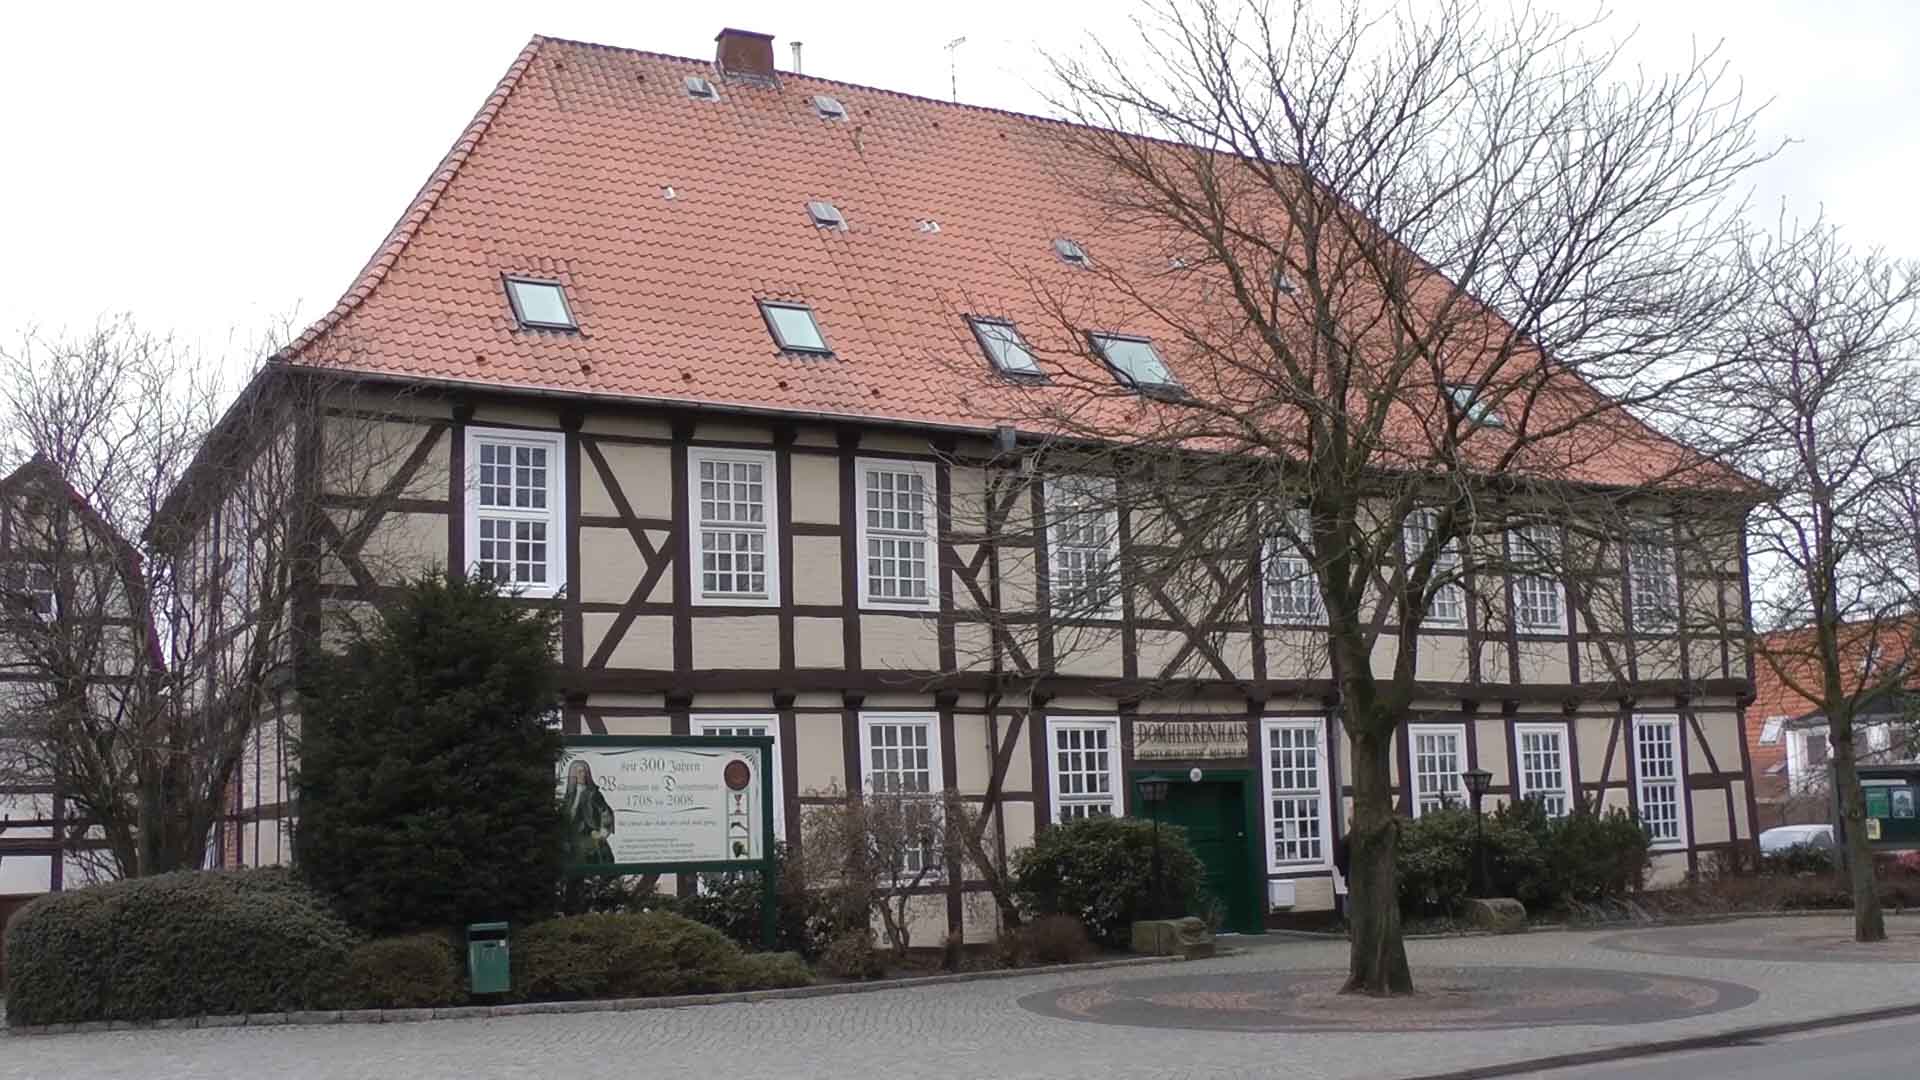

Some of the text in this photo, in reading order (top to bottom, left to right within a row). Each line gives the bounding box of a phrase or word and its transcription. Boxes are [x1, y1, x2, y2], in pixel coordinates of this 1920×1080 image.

[1137, 722, 1248, 745] DOMHERRENHAUS
[639, 758, 665, 772] 300
[665, 794, 694, 807] 2008
